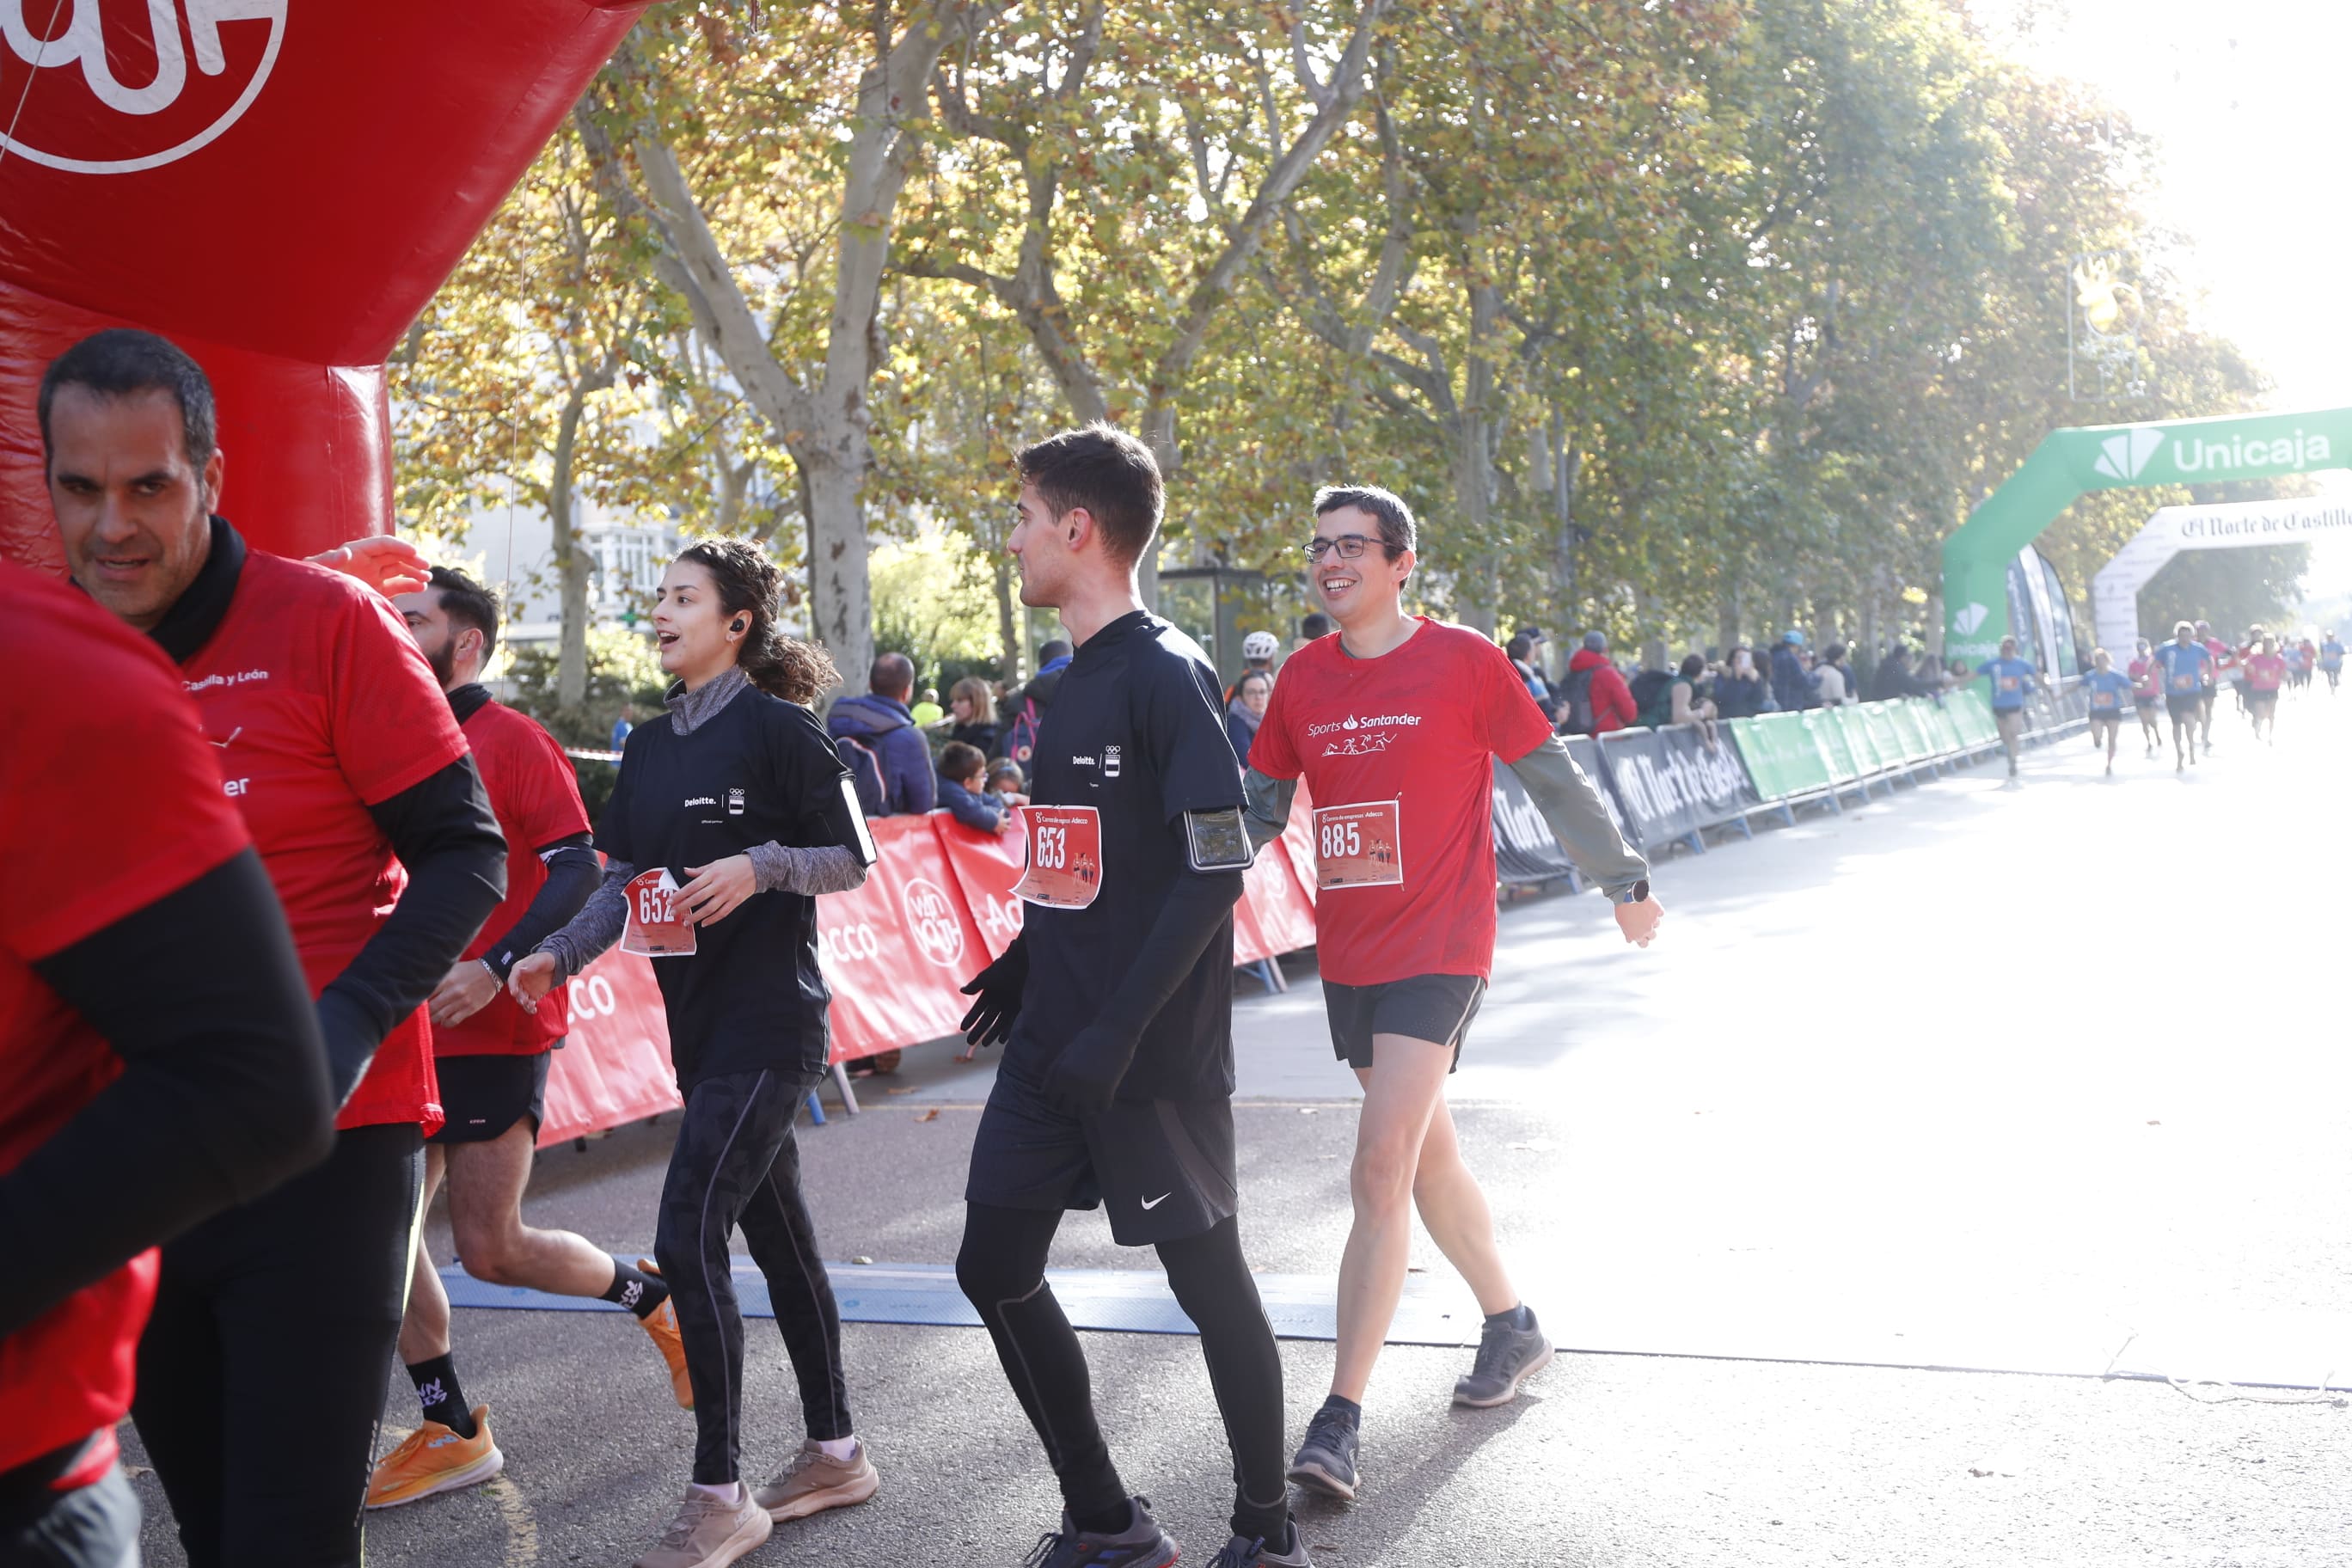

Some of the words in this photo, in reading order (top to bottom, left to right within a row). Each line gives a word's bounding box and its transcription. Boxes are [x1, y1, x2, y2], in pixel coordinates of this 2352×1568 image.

[2173, 428, 2331, 471] Unicaja
[2182, 518, 2204, 537] El
[2209, 518, 2257, 536] Norte
[2262, 516, 2278, 533] de
[227, 675, 235, 686] y
[237, 668, 269, 682] León
[1308, 721, 1341, 738] Sports
[1360, 713, 1422, 729] Santander
[1037, 826, 1065, 869] 653
[1321, 821, 1360, 859] 885
[639, 887, 675, 924] 652
